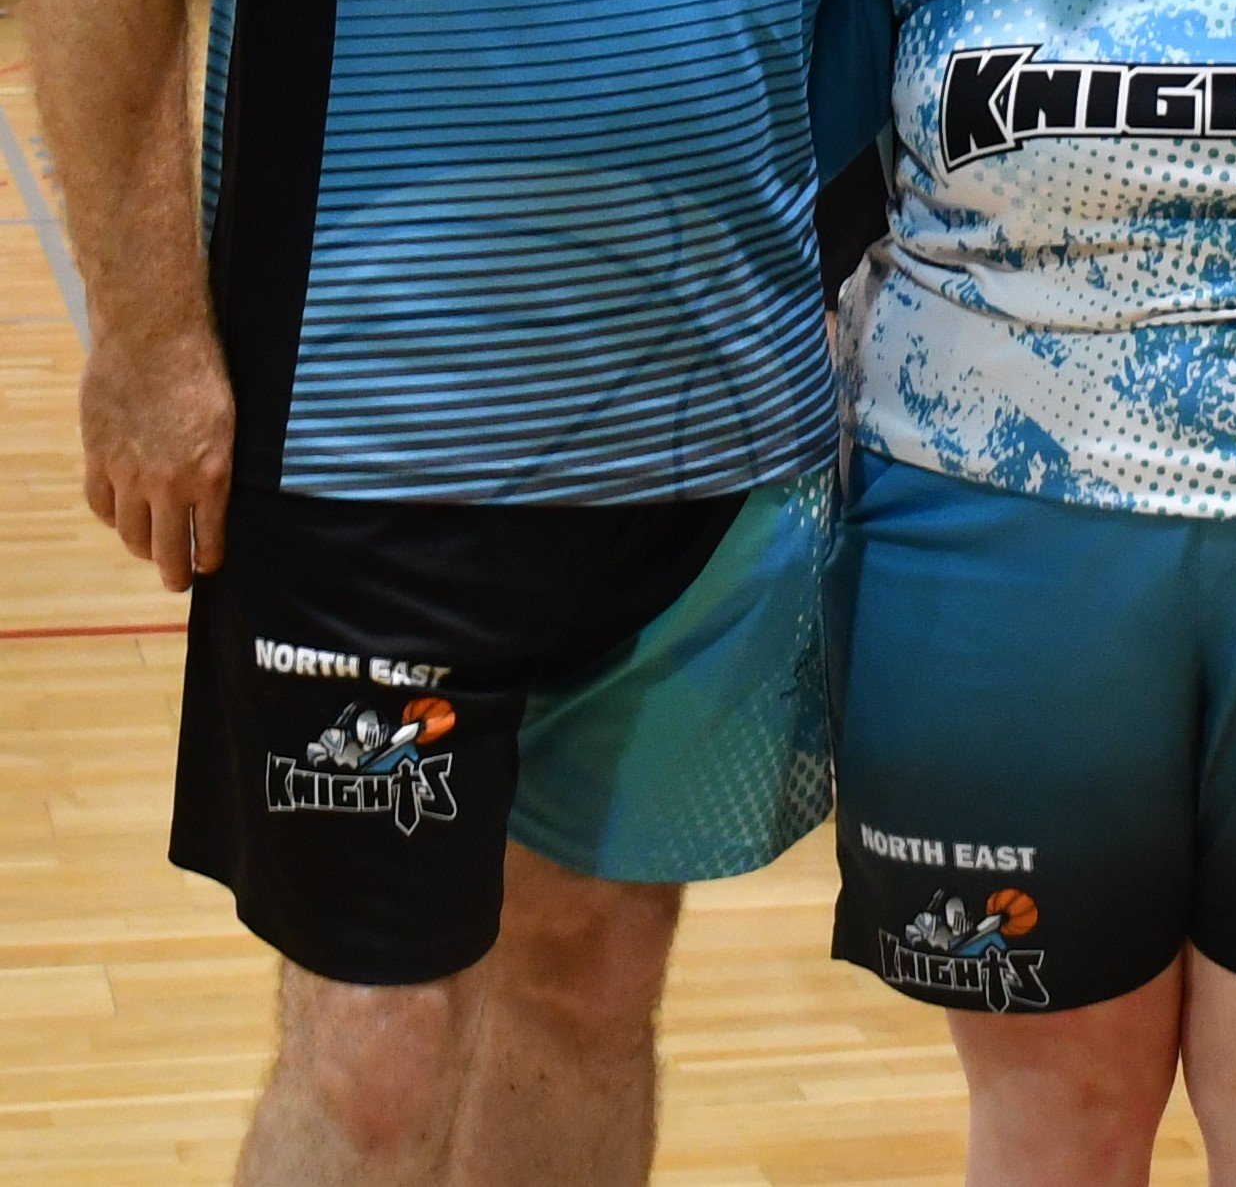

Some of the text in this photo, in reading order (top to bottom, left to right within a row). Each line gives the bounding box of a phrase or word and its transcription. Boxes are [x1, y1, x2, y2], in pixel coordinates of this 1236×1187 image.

[254, 636, 451, 688] NORTH EAST
[266, 751, 457, 836] KNIGHTS
[861, 823, 1037, 872] NORTH EAST
[878, 927, 1050, 1013] KNIGHTS
